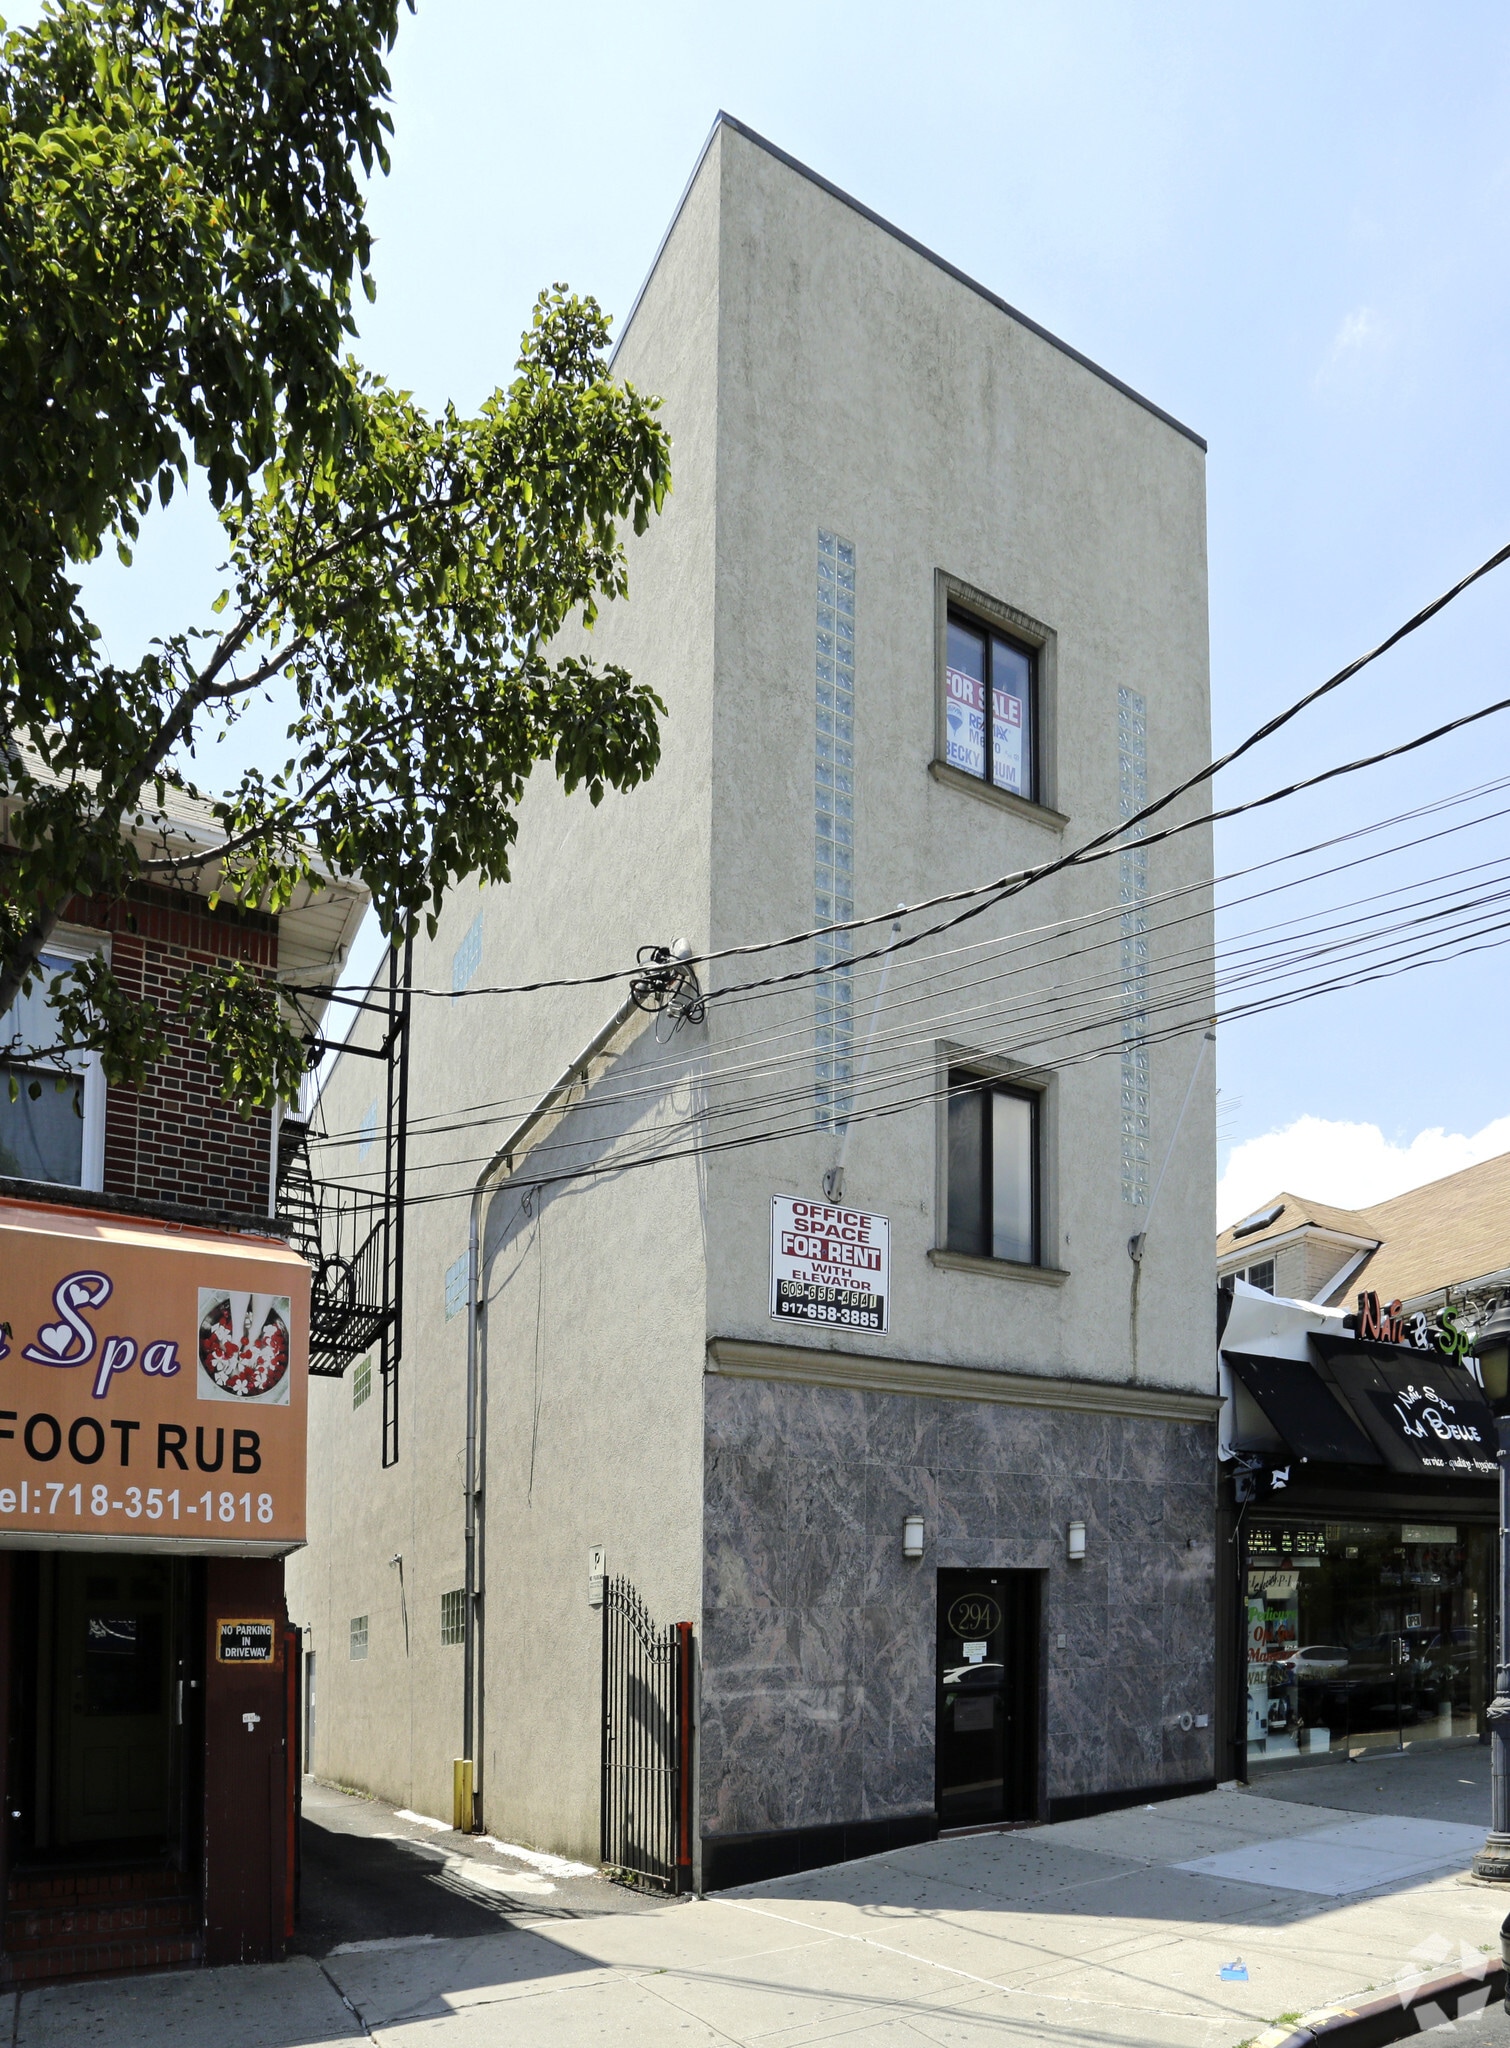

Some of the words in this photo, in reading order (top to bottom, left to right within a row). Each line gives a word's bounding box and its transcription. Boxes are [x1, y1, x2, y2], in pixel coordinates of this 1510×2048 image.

[792, 1202, 872, 1230] OFFICE
[794, 1218, 870, 1244] SPACE
[782, 1232, 822, 1259] FOR
[828, 1241, 880, 1269] RENT
[792, 1269, 871, 1291] ELEVATOR
[811, 1262, 852, 1278] WITH
[782, 1302, 879, 1327] 917-658-3885
[22, 1270, 181, 1400] Spa
[1410, 1311, 1428, 1350] &
[1438, 1306, 1479, 1366] Sp
[0, 1410, 140, 1467] FOOT
[157, 1423, 262, 1475] RUB
[1296, 1531, 1325, 1553] SPA
[958, 1602, 991, 1630] 294
[1407, 1615, 1421, 1628] OPEN
[221, 1625, 233, 1635] NO
[236, 1625, 271, 1636] PARKING
[242, 1636, 251, 1646] IN
[225, 1647, 267, 1657] DRIVEWAY
